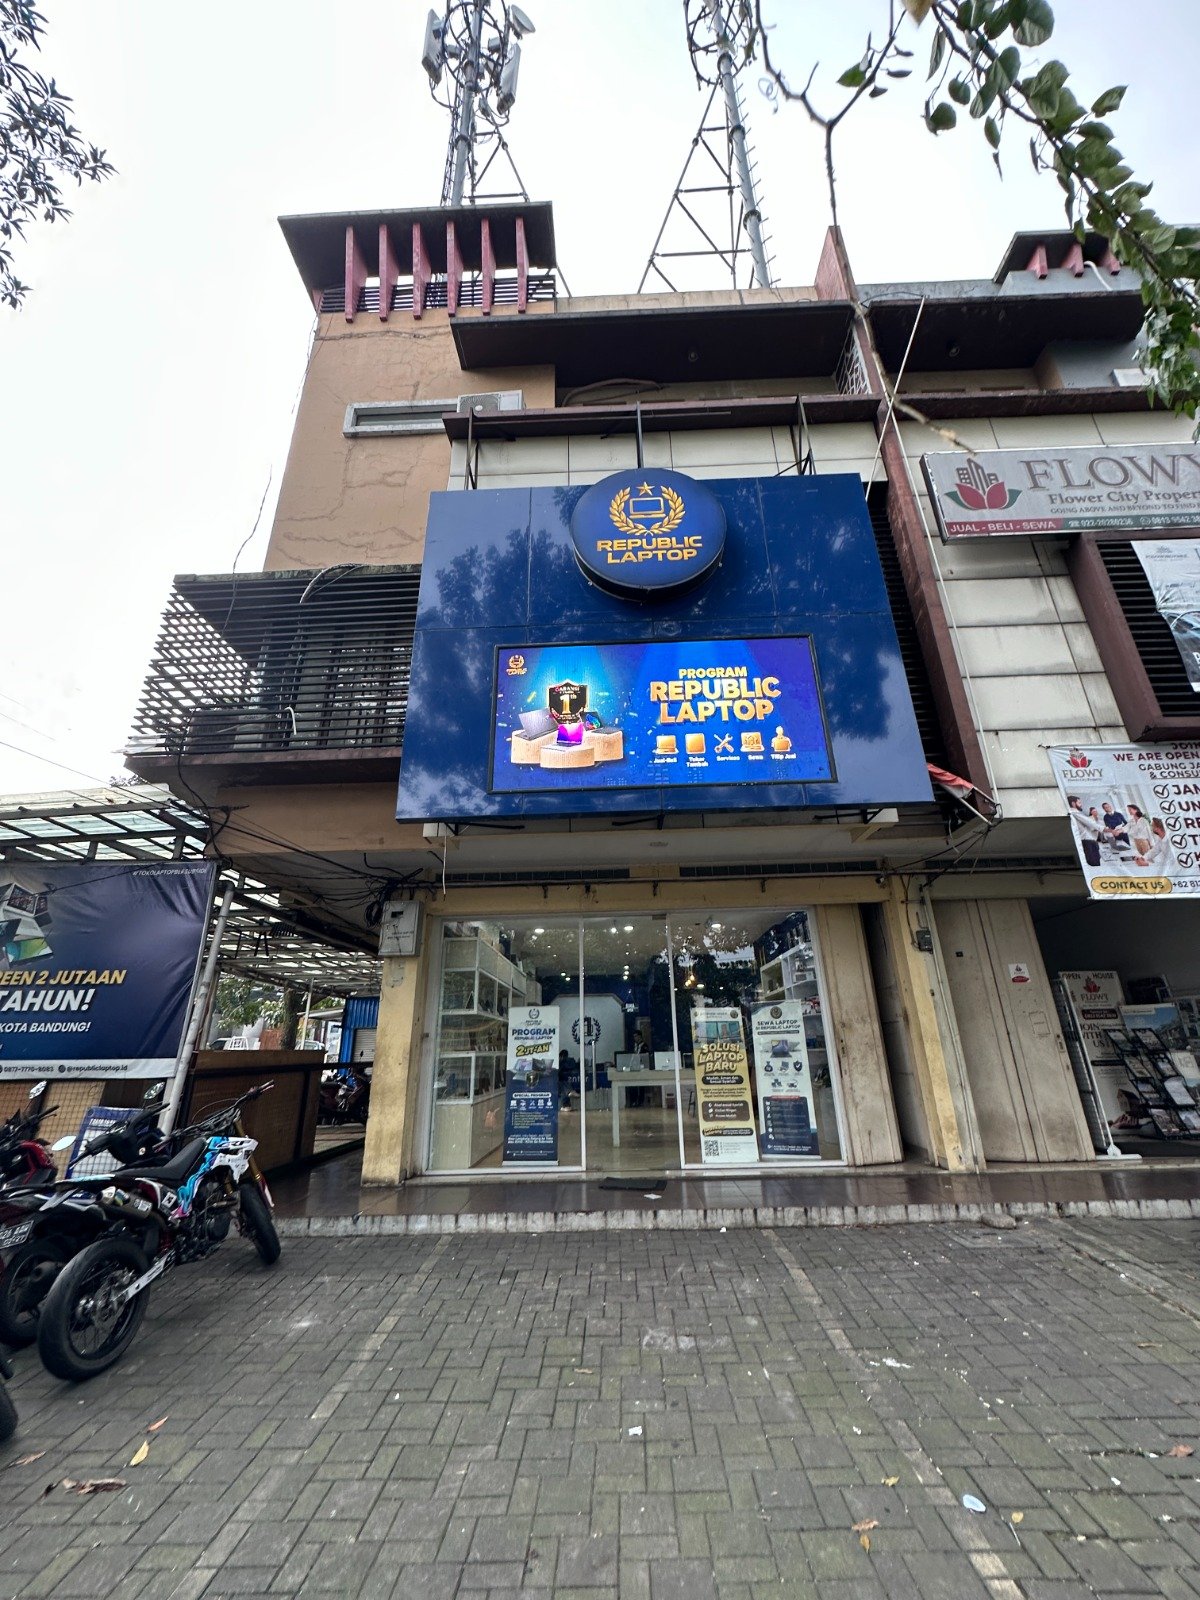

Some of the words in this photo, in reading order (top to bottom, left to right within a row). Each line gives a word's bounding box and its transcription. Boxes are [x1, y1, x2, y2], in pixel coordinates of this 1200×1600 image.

[1048, 493, 1103, 505] Flower
[1106, 490, 1140, 504] City
[1079, 505, 1105, 513] ABOVE
[1107, 504, 1126, 512] AND
[950, 523, 980, 533] JUAL
[987, 522, 1014, 531] BELI
[1022, 521, 1057, 530] SEWA
[596, 535, 703, 552] REPUBLIC
[607, 549, 698, 564] LAPTOP
[679, 666, 748, 679] PROGRAM
[650, 676, 782, 702] REPUBLIC
[660, 699, 774, 724] LAPTOP
[1113, 753, 1135, 761] WE
[1138, 752, 1162, 760] ARE
[1139, 762, 1187, 771] GABUNG
[1062, 768, 1103, 778] FLOWY
[1100, 881, 1148, 890] CONTACT
[1151, 880, 1165, 889] US
[1172, 880, 1188, 888] +62
[36, 970, 49, 986] 2
[49, 969, 127, 985] JUTAAN
[29, 1021, 92, 1033] BANDUNG!
[512, 1028, 556, 1036] PROGRAM
[702, 1042, 740, 1053] SOLUSI
[699, 1051, 745, 1064] LAPTOP
[705, 1061, 737, 1072] BARU
